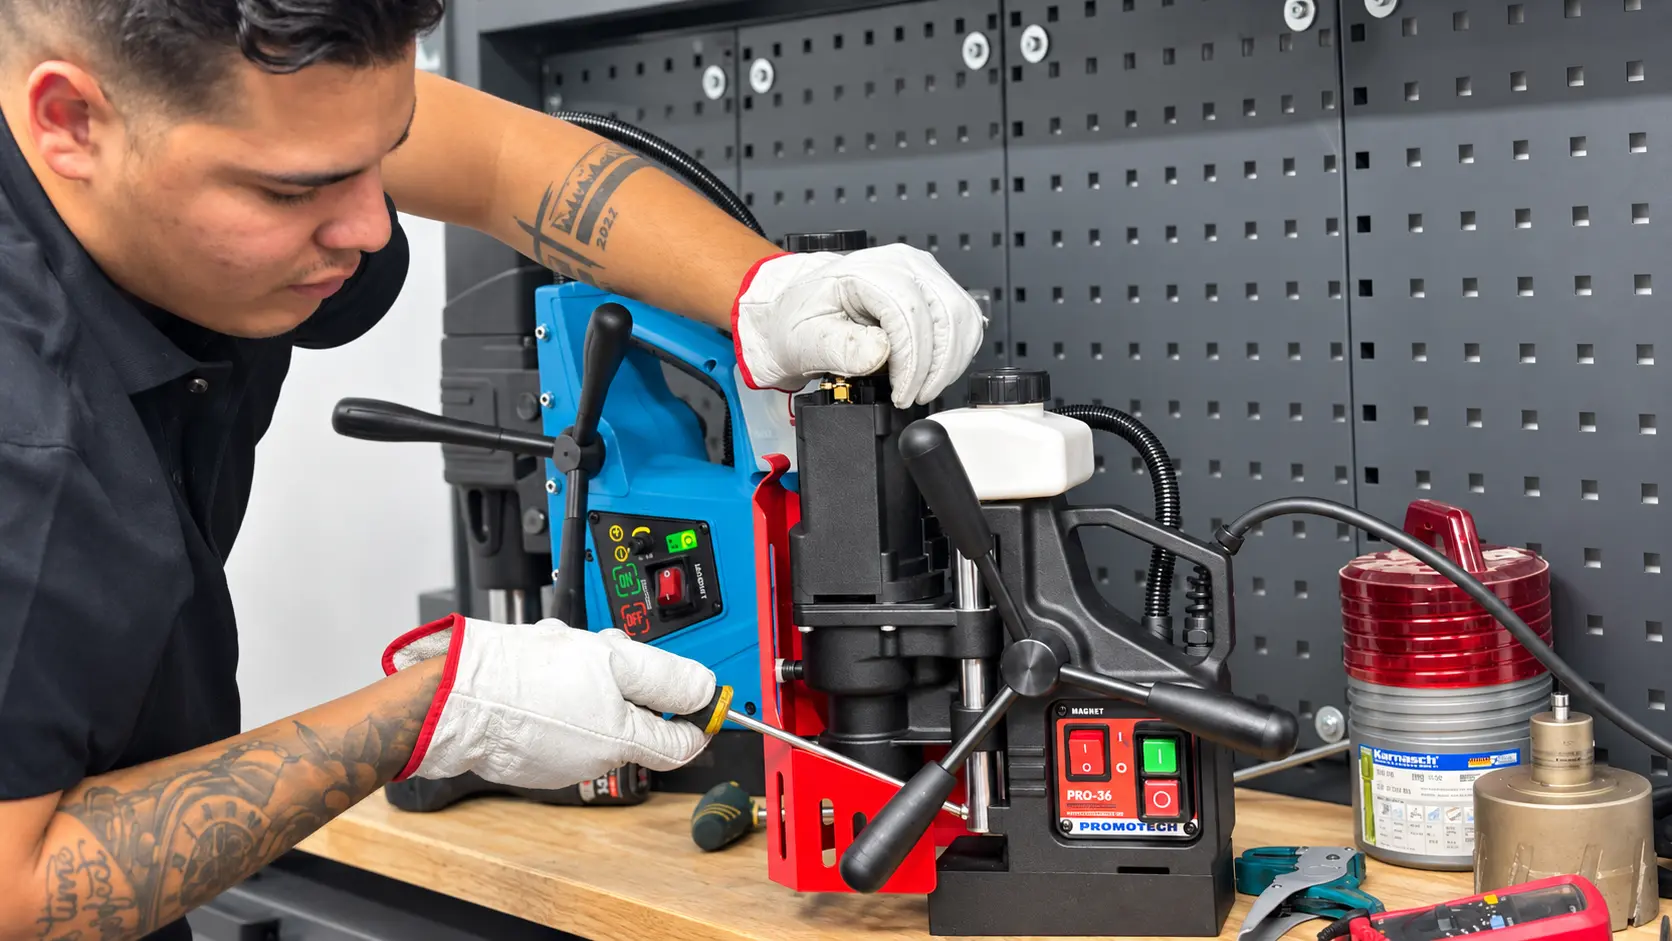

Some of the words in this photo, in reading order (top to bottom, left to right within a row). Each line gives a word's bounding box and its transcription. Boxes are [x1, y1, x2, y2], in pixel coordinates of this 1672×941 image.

[619, 571, 634, 588] ON
[626, 610, 643, 628] OFF
[1071, 707, 1104, 716] MAGNET
[1066, 789, 1112, 801] PRO-36
[1079, 821, 1178, 832] PROMOTECH
